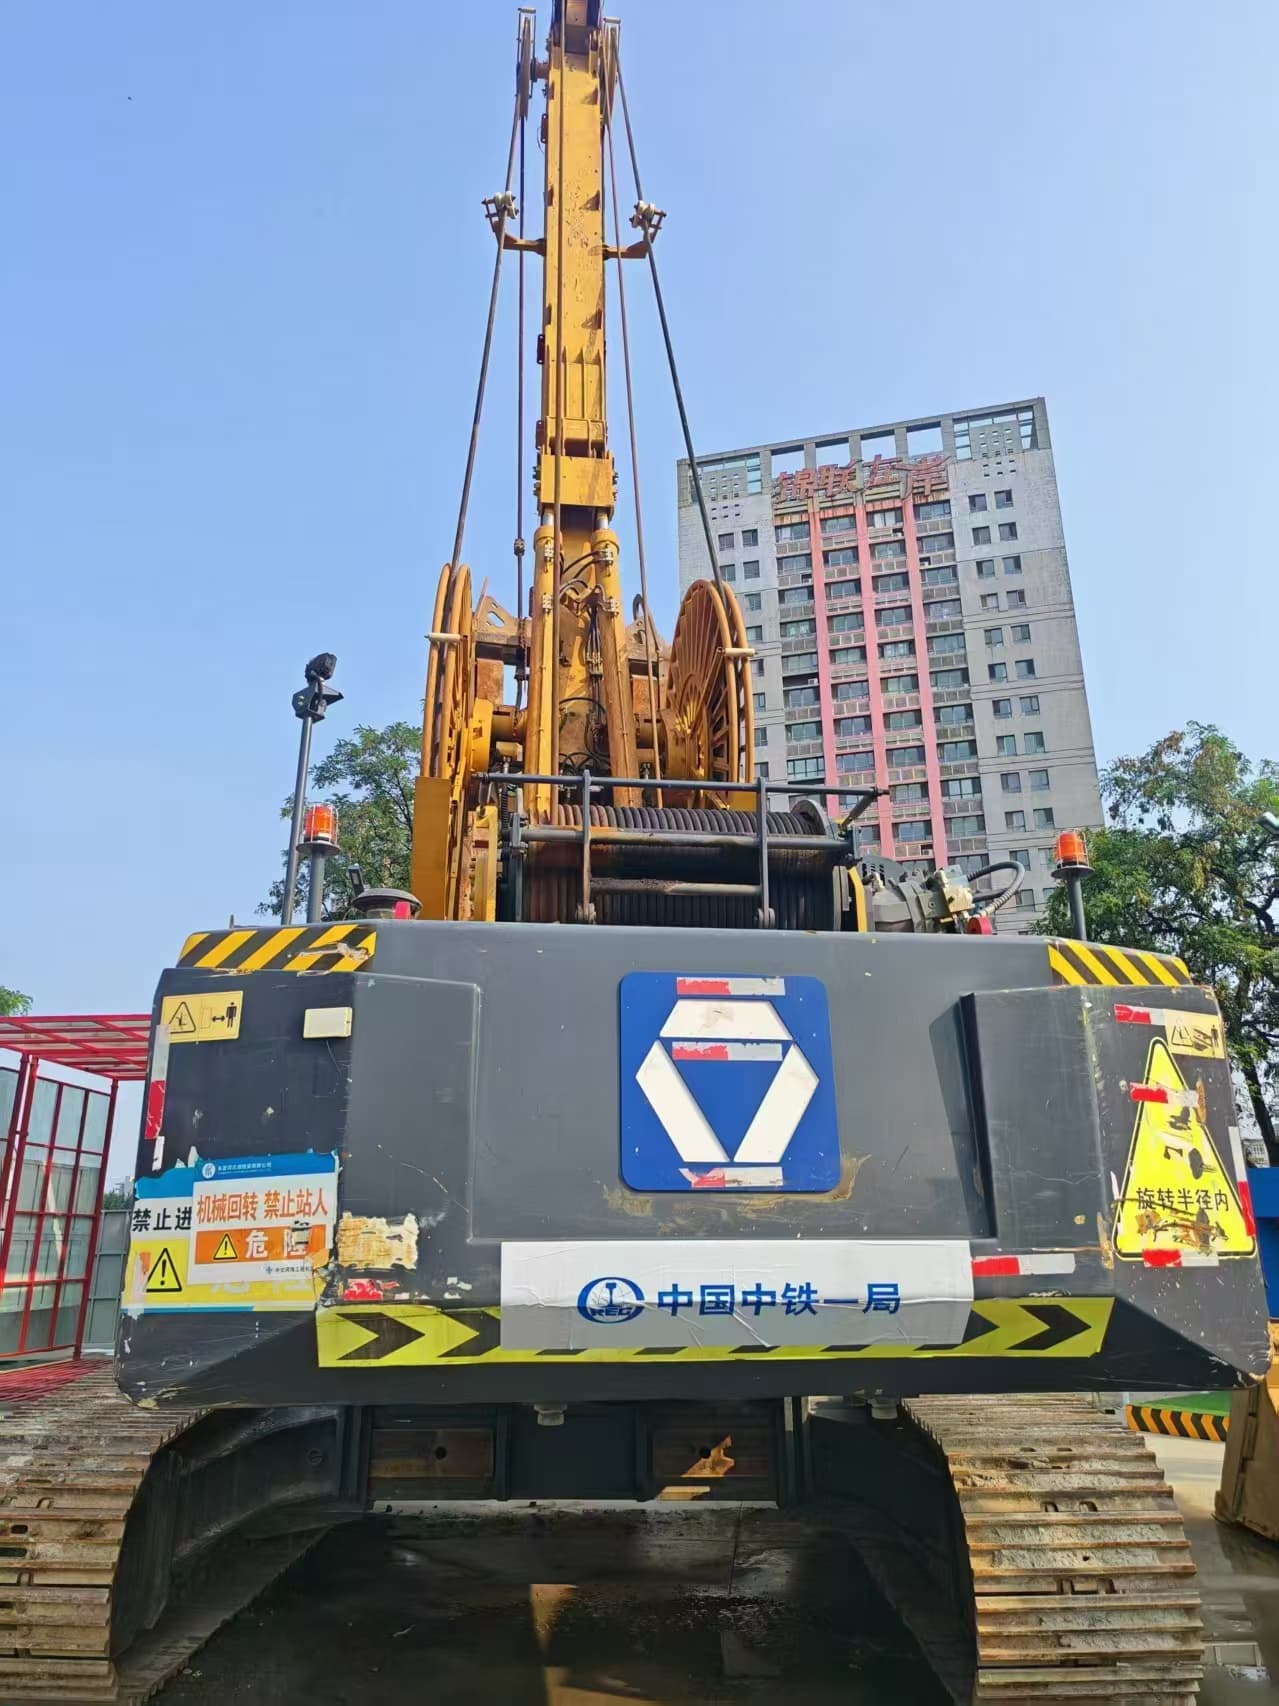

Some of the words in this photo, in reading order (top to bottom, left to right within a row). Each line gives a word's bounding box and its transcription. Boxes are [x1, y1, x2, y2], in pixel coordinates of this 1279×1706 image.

[197, 1191, 258, 1224] 机械回转
[263, 1188, 328, 1223] 禁止站人
[1135, 1187, 1229, 1211] 旋转半径内
[657, 1282, 900, 1316] 中国中铁一局
